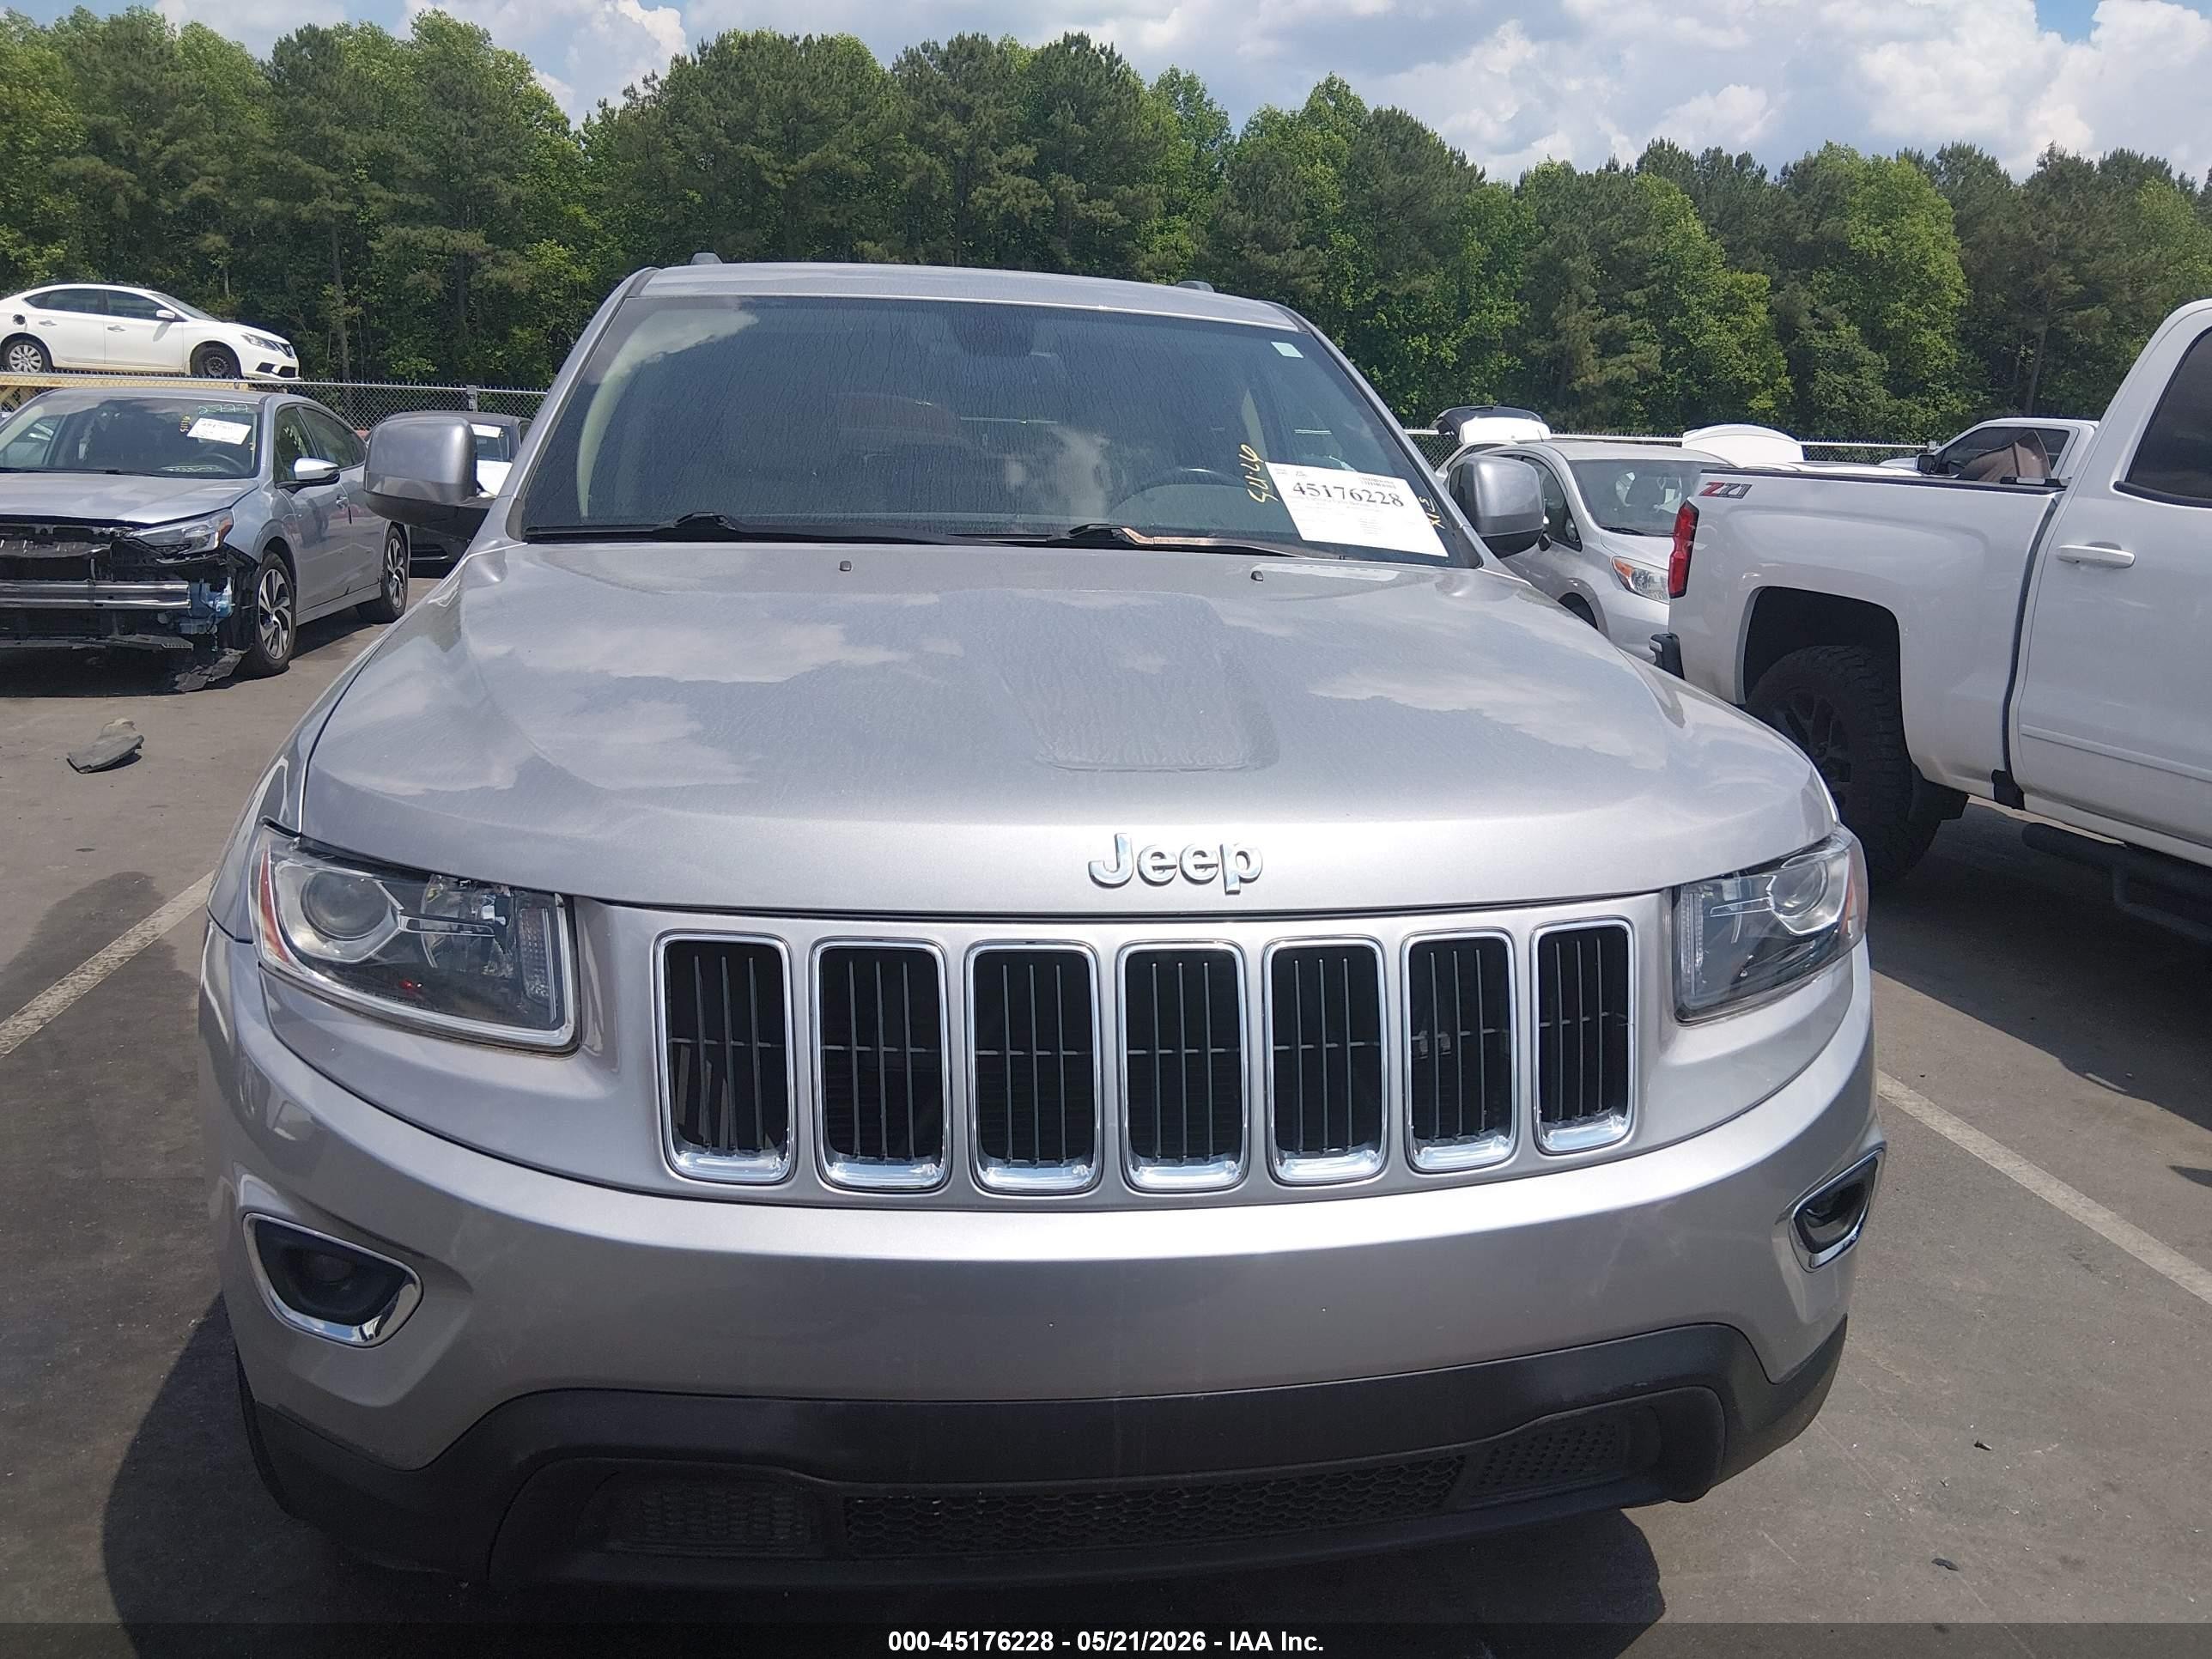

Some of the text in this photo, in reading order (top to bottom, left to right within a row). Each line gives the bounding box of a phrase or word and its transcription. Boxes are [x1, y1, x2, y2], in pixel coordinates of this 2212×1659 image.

[1292, 482, 1404, 507] 45176228
[1698, 481, 1753, 499] Z71
[1087, 832, 1263, 896] Jeep
